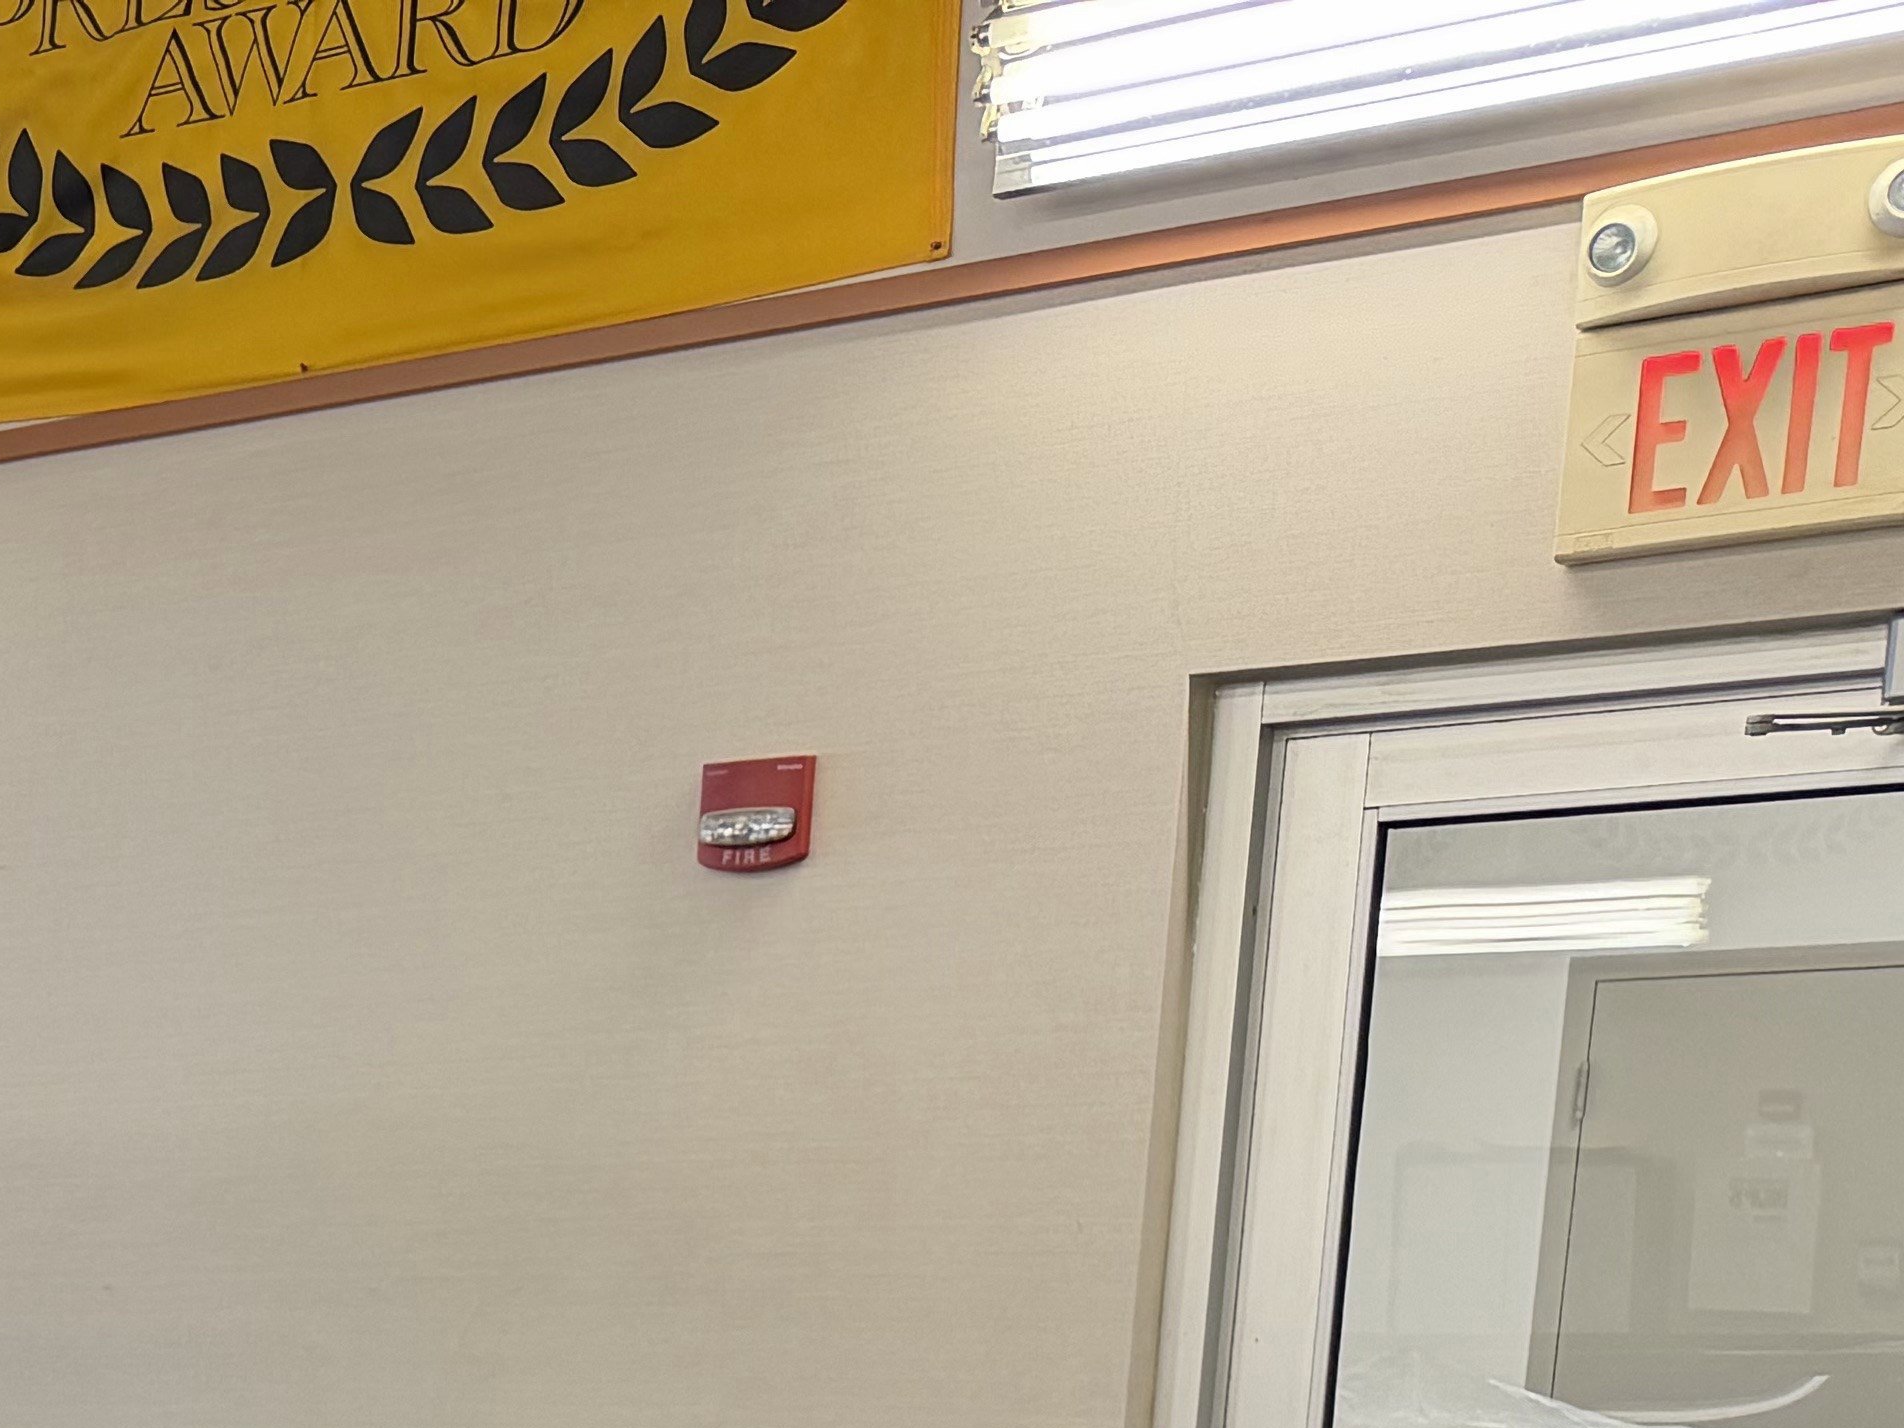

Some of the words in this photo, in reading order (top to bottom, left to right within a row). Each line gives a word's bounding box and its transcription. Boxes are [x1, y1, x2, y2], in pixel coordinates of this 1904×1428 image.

[119, 0, 586, 138] AWARD
[1628, 321, 1895, 514] EXIT
[721, 846, 772, 866] FIRE
